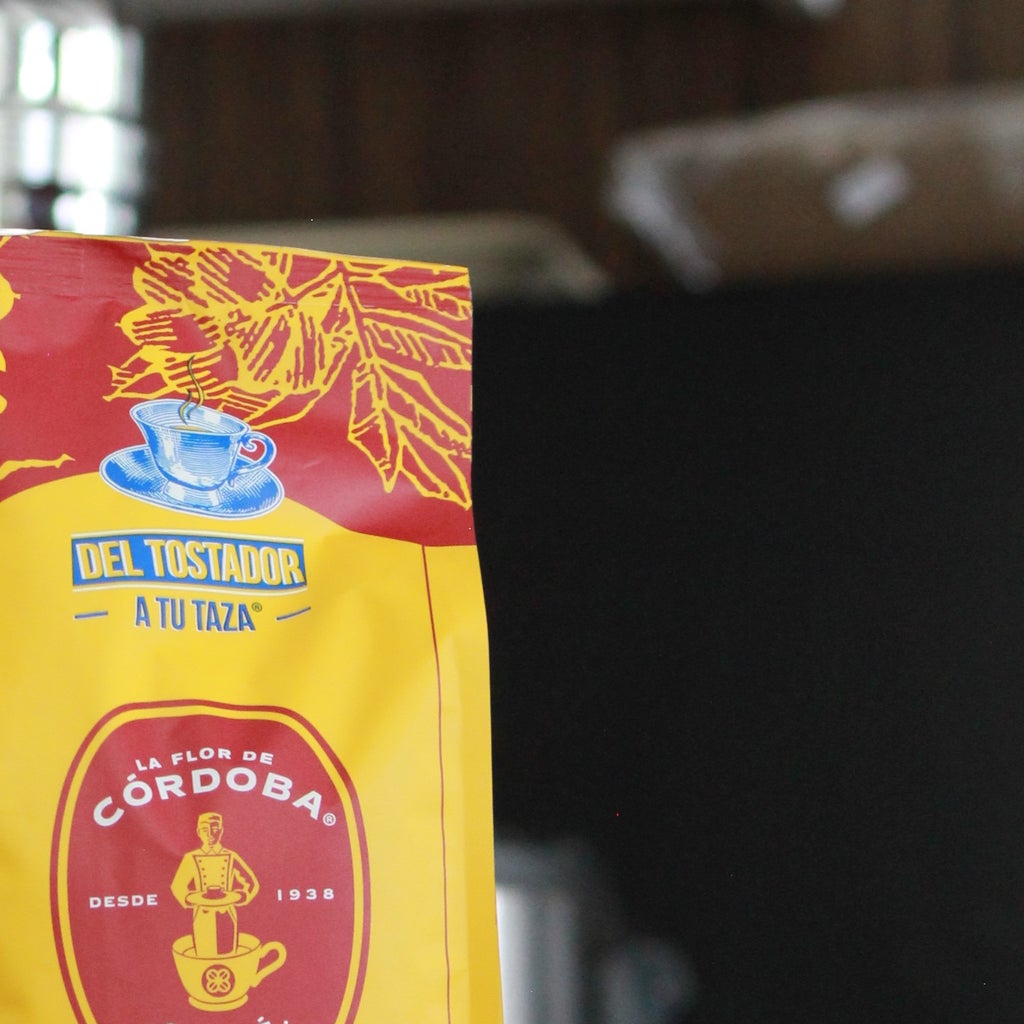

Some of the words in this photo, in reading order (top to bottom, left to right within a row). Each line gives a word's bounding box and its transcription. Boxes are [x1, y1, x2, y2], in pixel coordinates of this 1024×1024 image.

[75, 539, 145, 580] DEL
[144, 538, 306, 586] TOSTADOR
[135, 595, 151, 629] A
[155, 596, 186, 631] TU
[135, 757, 163, 772] LA
[171, 747, 232, 766] FLOR
[242, 751, 275, 765] DE
[89, 893, 159, 909] DESDE
[277, 888, 335, 901] 1938
